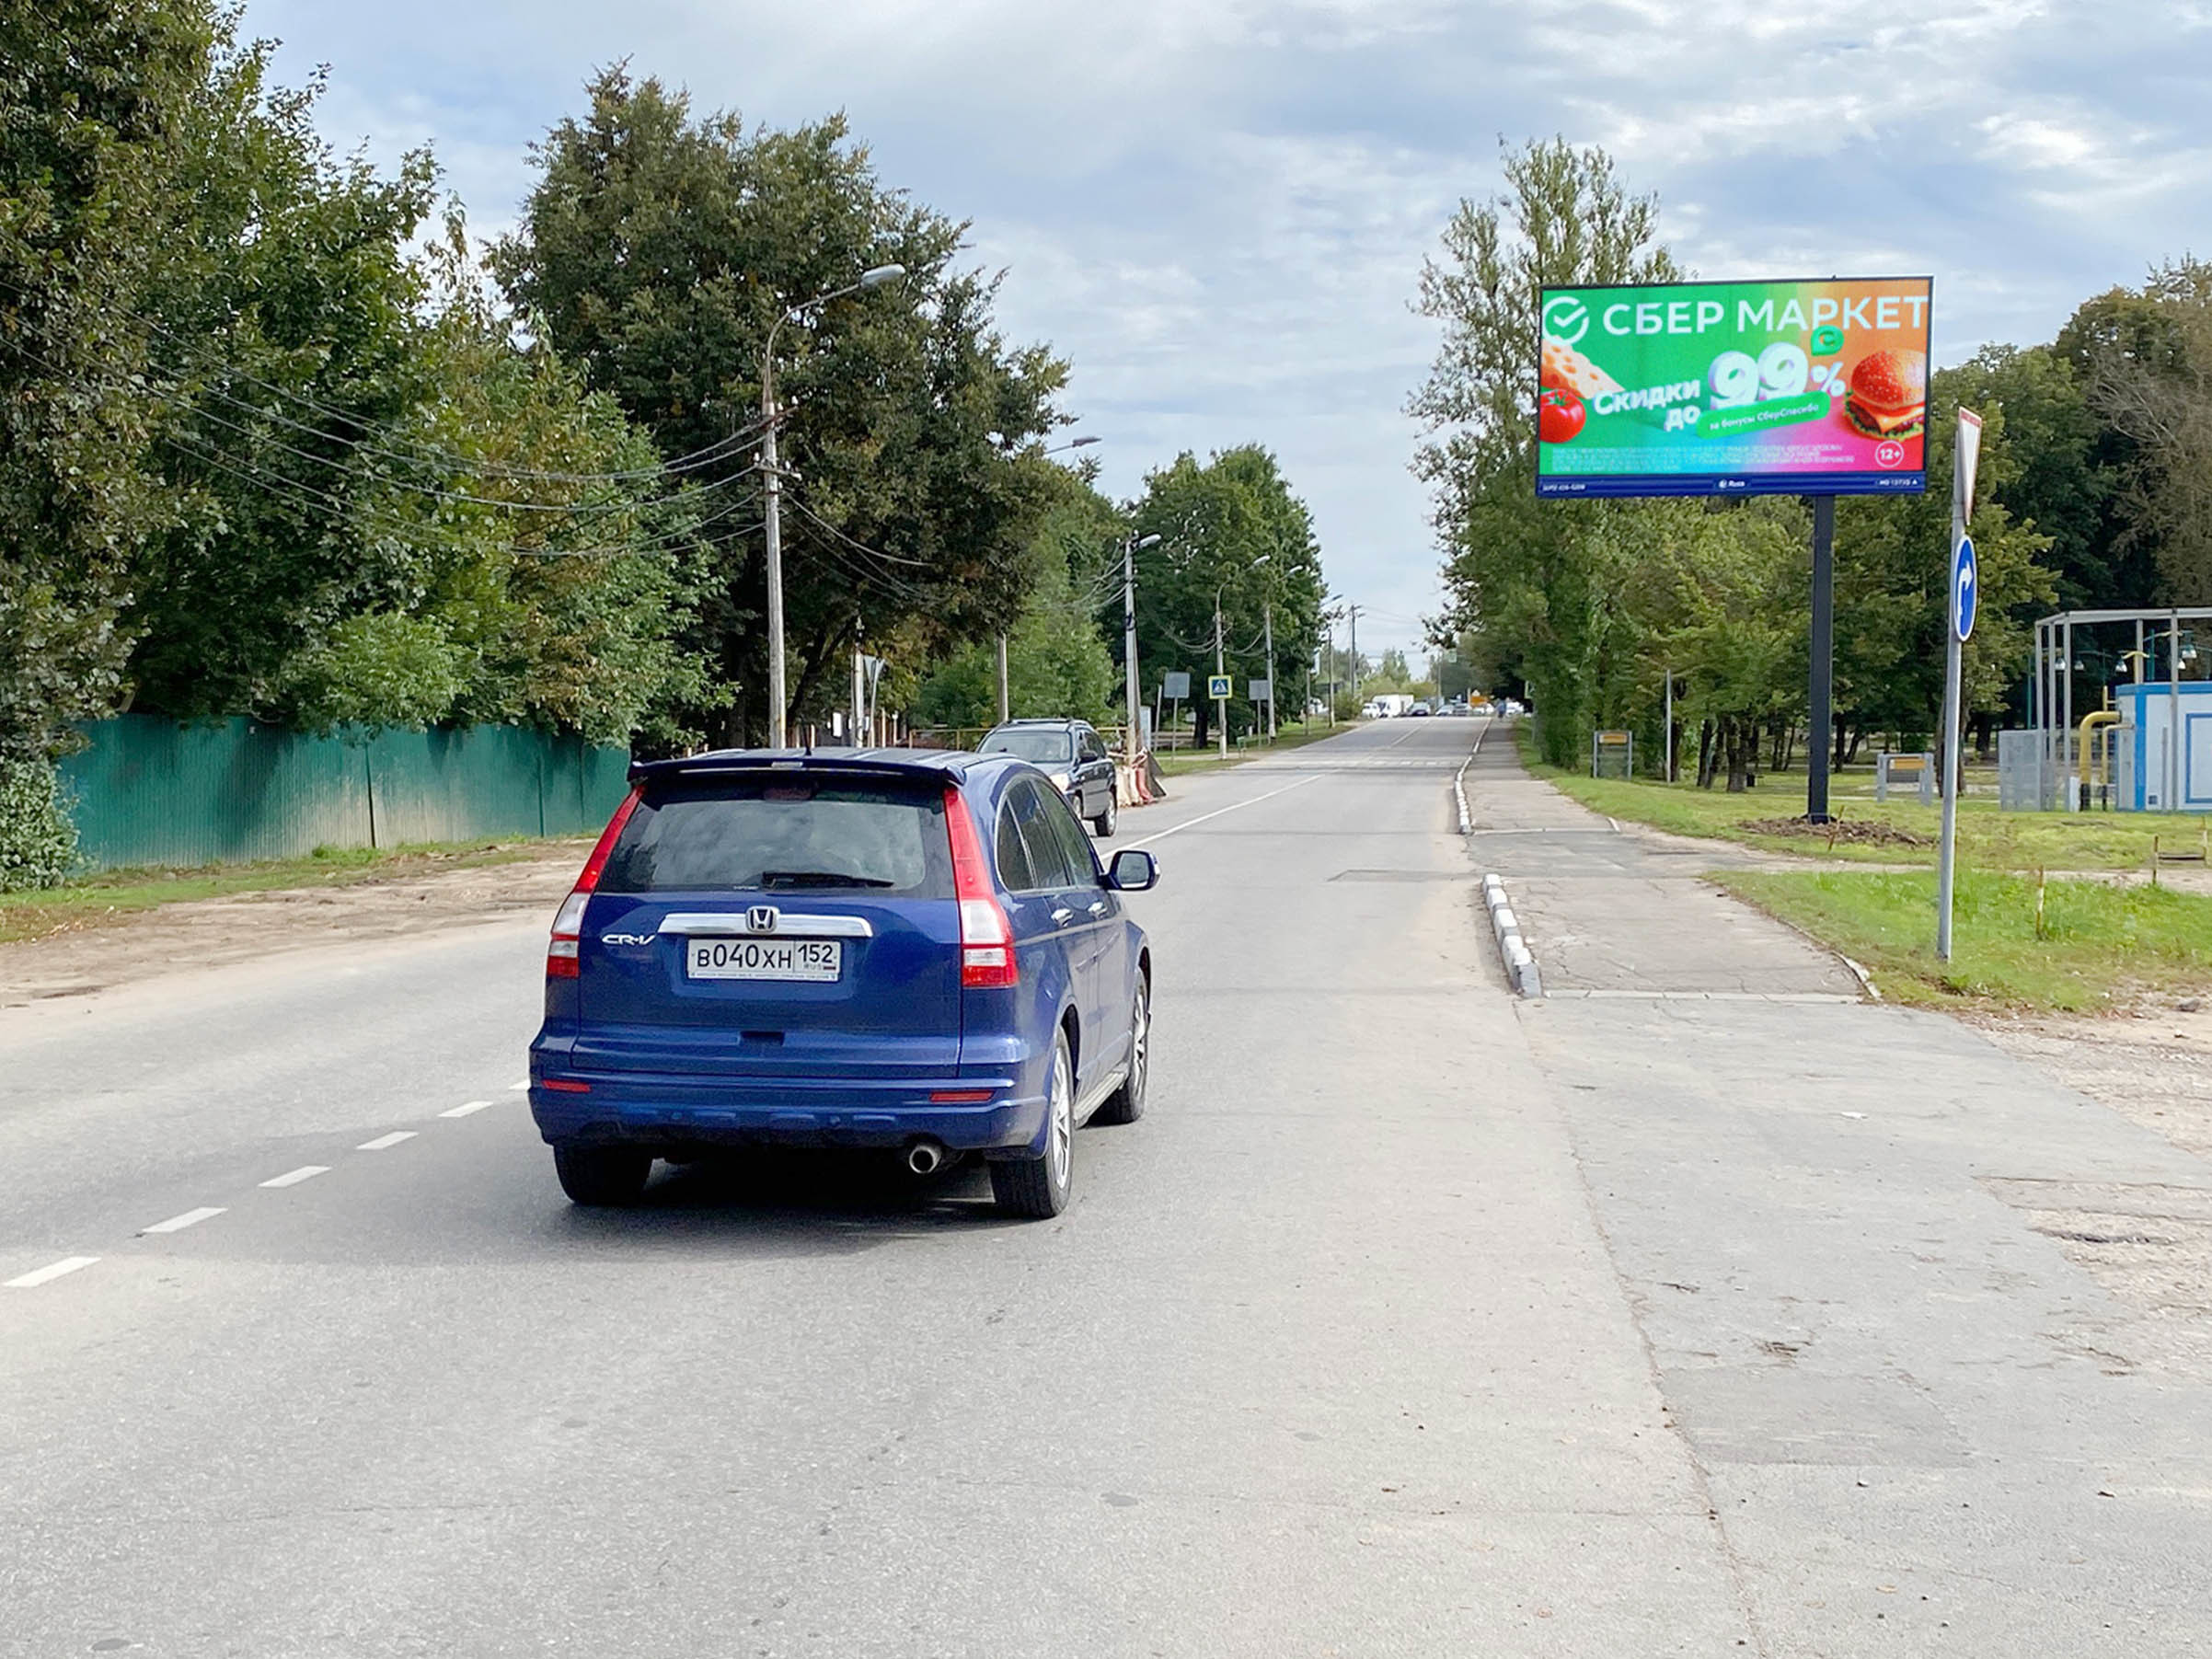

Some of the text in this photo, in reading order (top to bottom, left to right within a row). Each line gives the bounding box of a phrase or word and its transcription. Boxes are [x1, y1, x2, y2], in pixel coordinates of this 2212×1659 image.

[1602, 295, 1928, 336] СБЕР МАРКЕТ
[1708, 341, 1846, 410] 99%
[1593, 380, 1700, 415] Скидки
[1879, 448, 1903, 461] 12+
[697, 943, 834, 969] В040ХН 152
